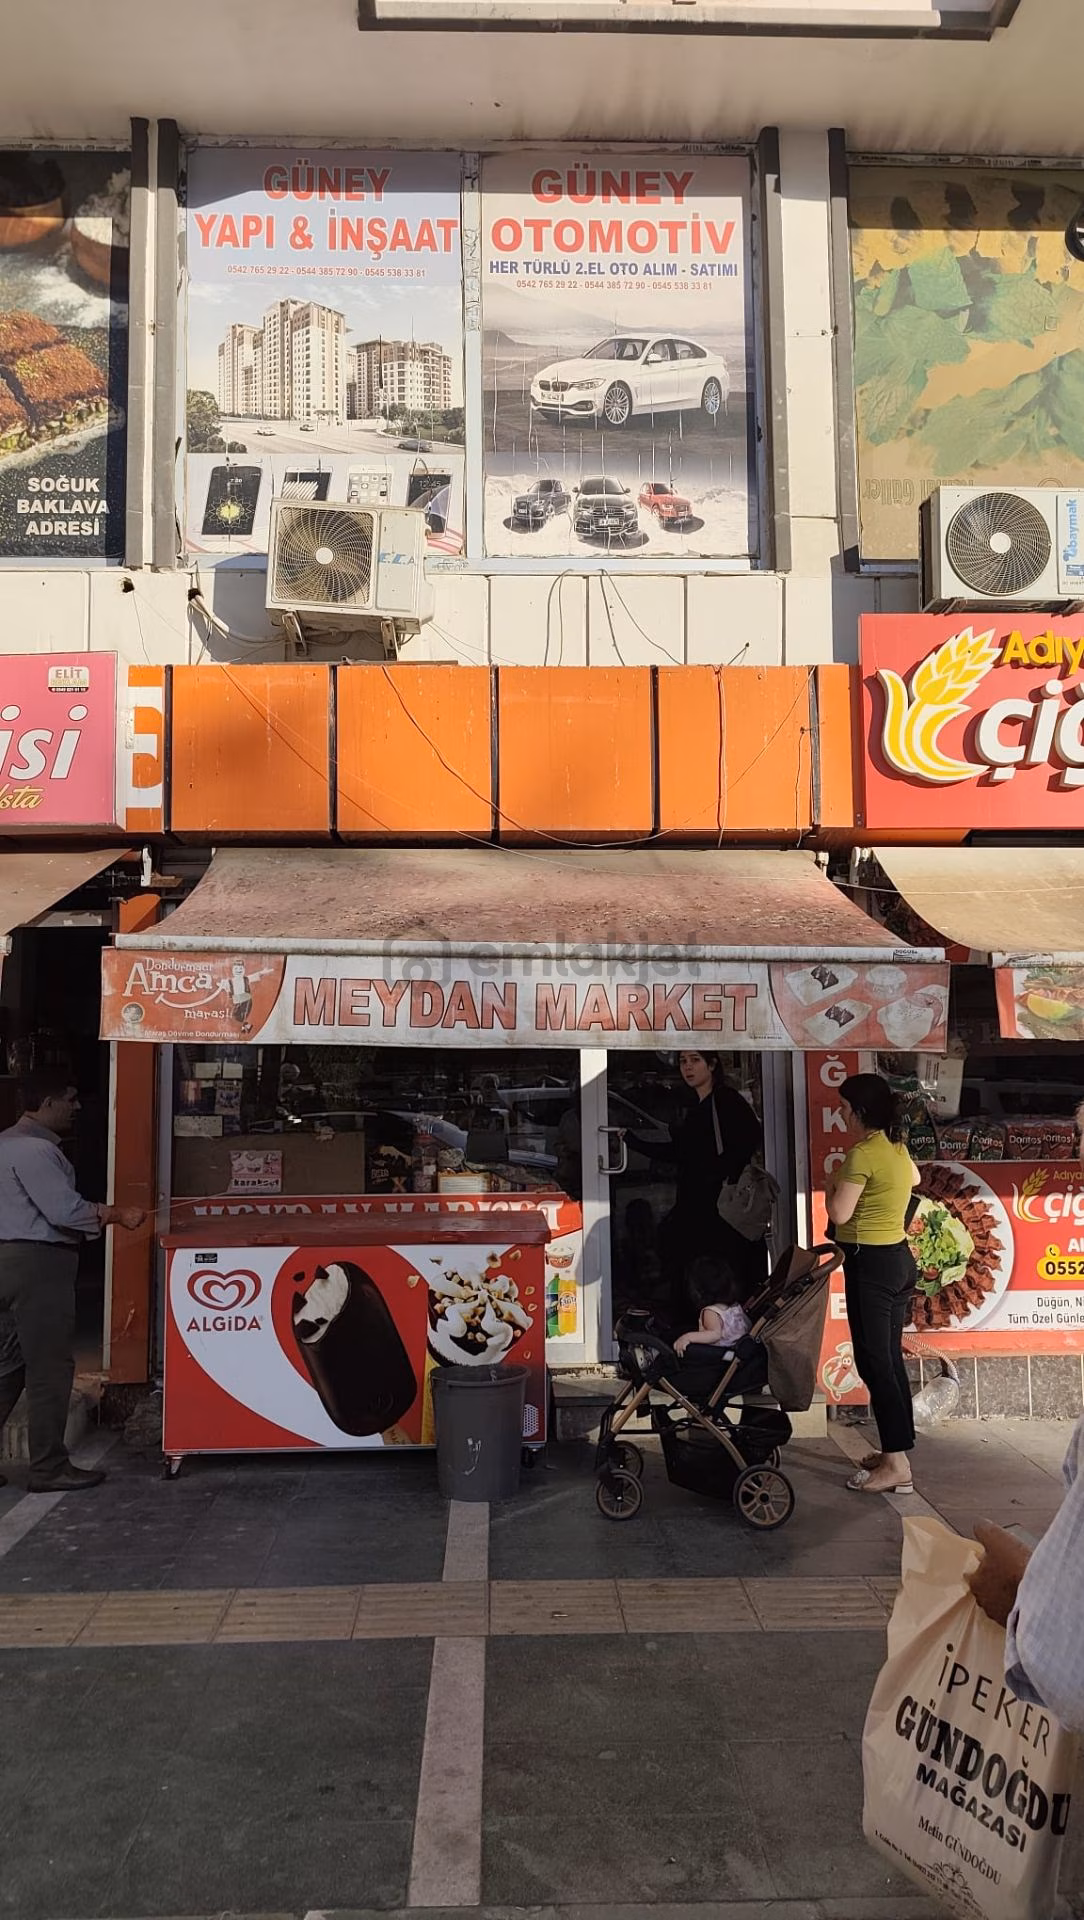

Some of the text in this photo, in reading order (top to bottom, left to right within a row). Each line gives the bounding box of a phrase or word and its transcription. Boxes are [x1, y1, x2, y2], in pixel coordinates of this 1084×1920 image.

[264, 160, 391, 201] GÜNEY
[531, 163, 694, 204] GÜNEY
[194, 209, 458, 260] YAPI & İNŞAAT
[491, 212, 735, 254] OTOMOTİV
[227, 265, 247, 274] 0542
[250, 265, 265, 275] 765
[267, 266, 277, 275] 29
[279, 266, 289, 275] 22
[296, 266, 316, 276] 0544
[318, 267, 334, 276] 385
[336, 267, 346, 276] 72
[348, 267, 358, 277] 90
[365, 268, 385, 277] 0545
[404, 269, 414, 277] 33
[416, 269, 426, 278] 81
[489, 260, 518, 274] HER
[523, 259, 570, 275] TÜRLÜ
[575, 262, 605, 275] 2.EL
[610, 263, 638, 275] OTO
[643, 263, 677, 276] ALIM
[690, 263, 738, 277] SATIMI
[517, 280, 537, 289] 0542
[538, 281, 554, 289] 765
[556, 281, 566, 289] 29
[568, 281, 578, 289] 22
[585, 281, 604, 290] 0544
[607, 281, 621, 290] 385
[624, 281, 633, 290] 72
[635, 282, 645, 290] 90
[652, 282, 672, 290] 0545
[674, 282, 689, 290] 538
[28, 474, 99, 492] SOĞUK
[17, 499, 110, 514] BAKLAVA
[25, 517, 99, 536] ADRESİ
[1066, 499, 1079, 548] baymak
[55, 666, 82, 679] ELİT
[0, 783, 44, 809] sta
[122, 962, 213, 997] Amca
[293, 977, 758, 1032] MEYDAN MARKET
[972, 1135, 1004, 1147] Doritos
[1009, 1135, 1042, 1144] Doritos
[1037, 1296, 1073, 1310] Düğün,
[1008, 1313, 1029, 1324] Tüm
[1032, 1311, 1053, 1324] Özel
[938, 1643, 1050, 1756] İPEKER
[895, 1695, 1071, 1835] GÜNDOĞDU
[916, 1763, 1026, 1852] MAĞAZASI
[918, 1815, 944, 1843] Metin
[945, 1834, 1002, 1886] GÜNDOĞDU
